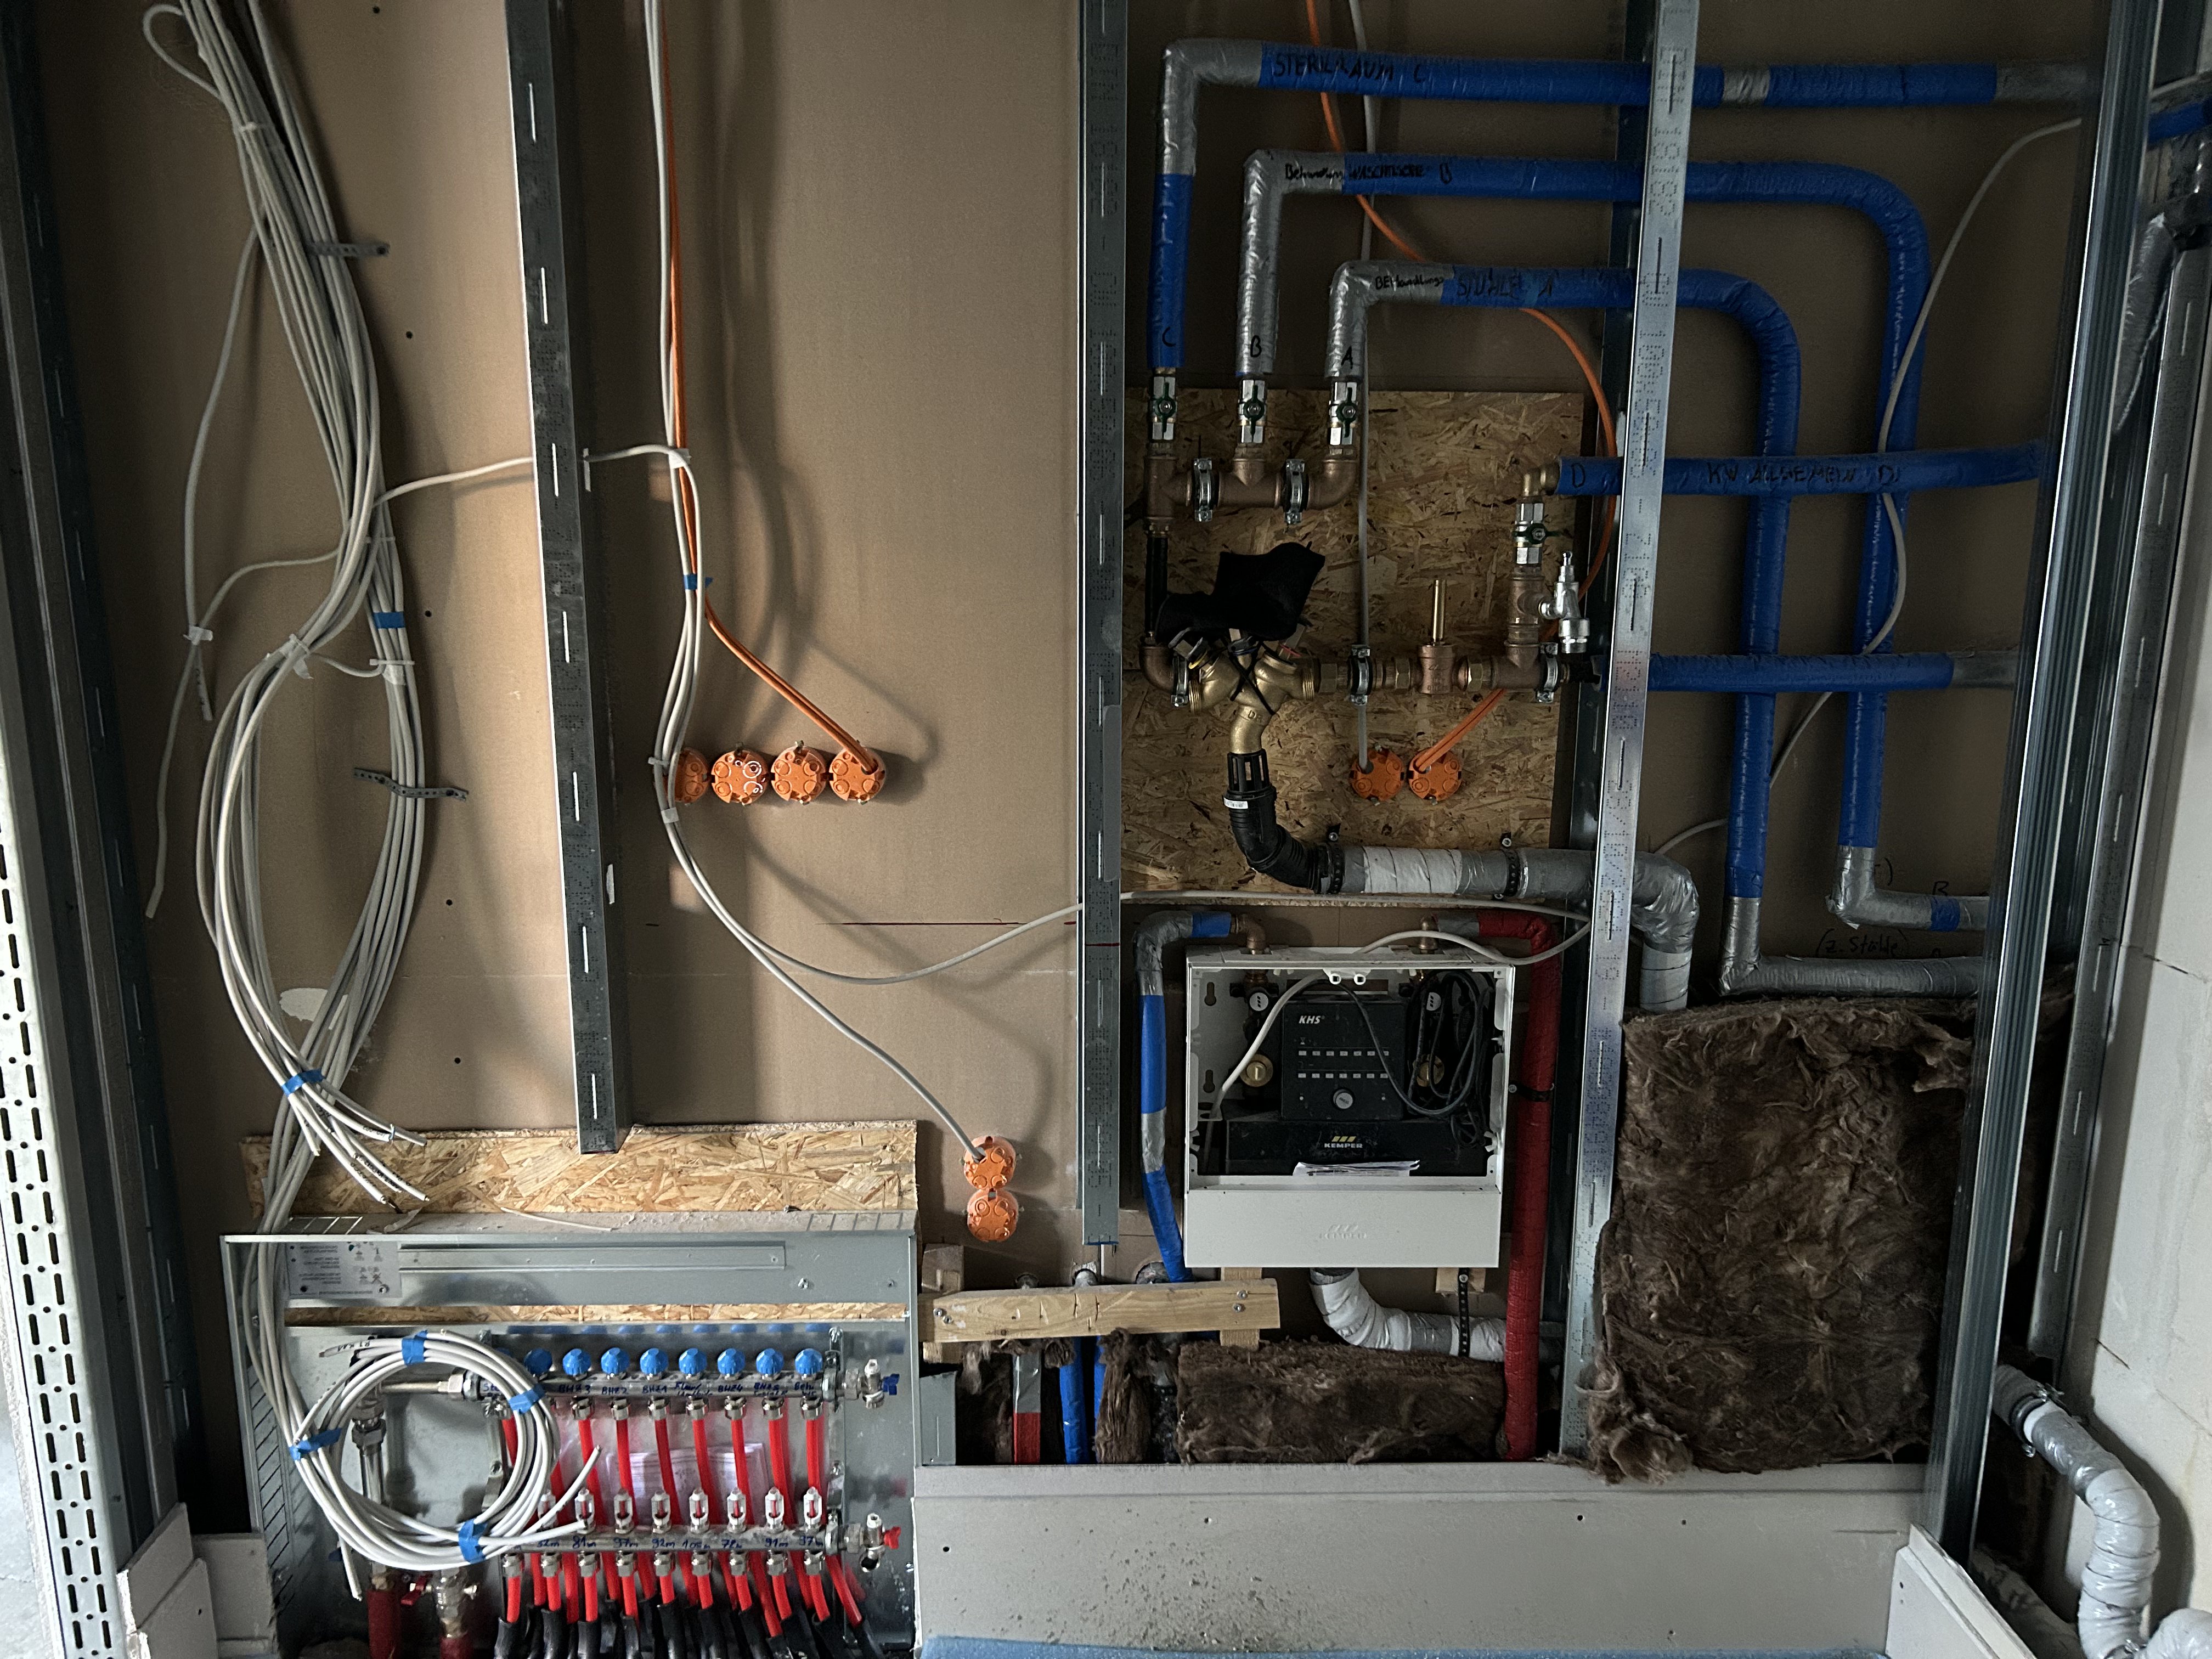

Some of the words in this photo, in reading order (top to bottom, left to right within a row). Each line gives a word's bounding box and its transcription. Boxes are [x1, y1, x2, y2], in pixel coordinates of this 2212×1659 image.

[1412, 63, 1427, 84] C
[1161, 325, 1176, 347] C
[1250, 335, 1262, 358] B
[1340, 346, 1354, 370] A
[1571, 462, 1586, 488] D
[1298, 1015, 1322, 1024] KHS
